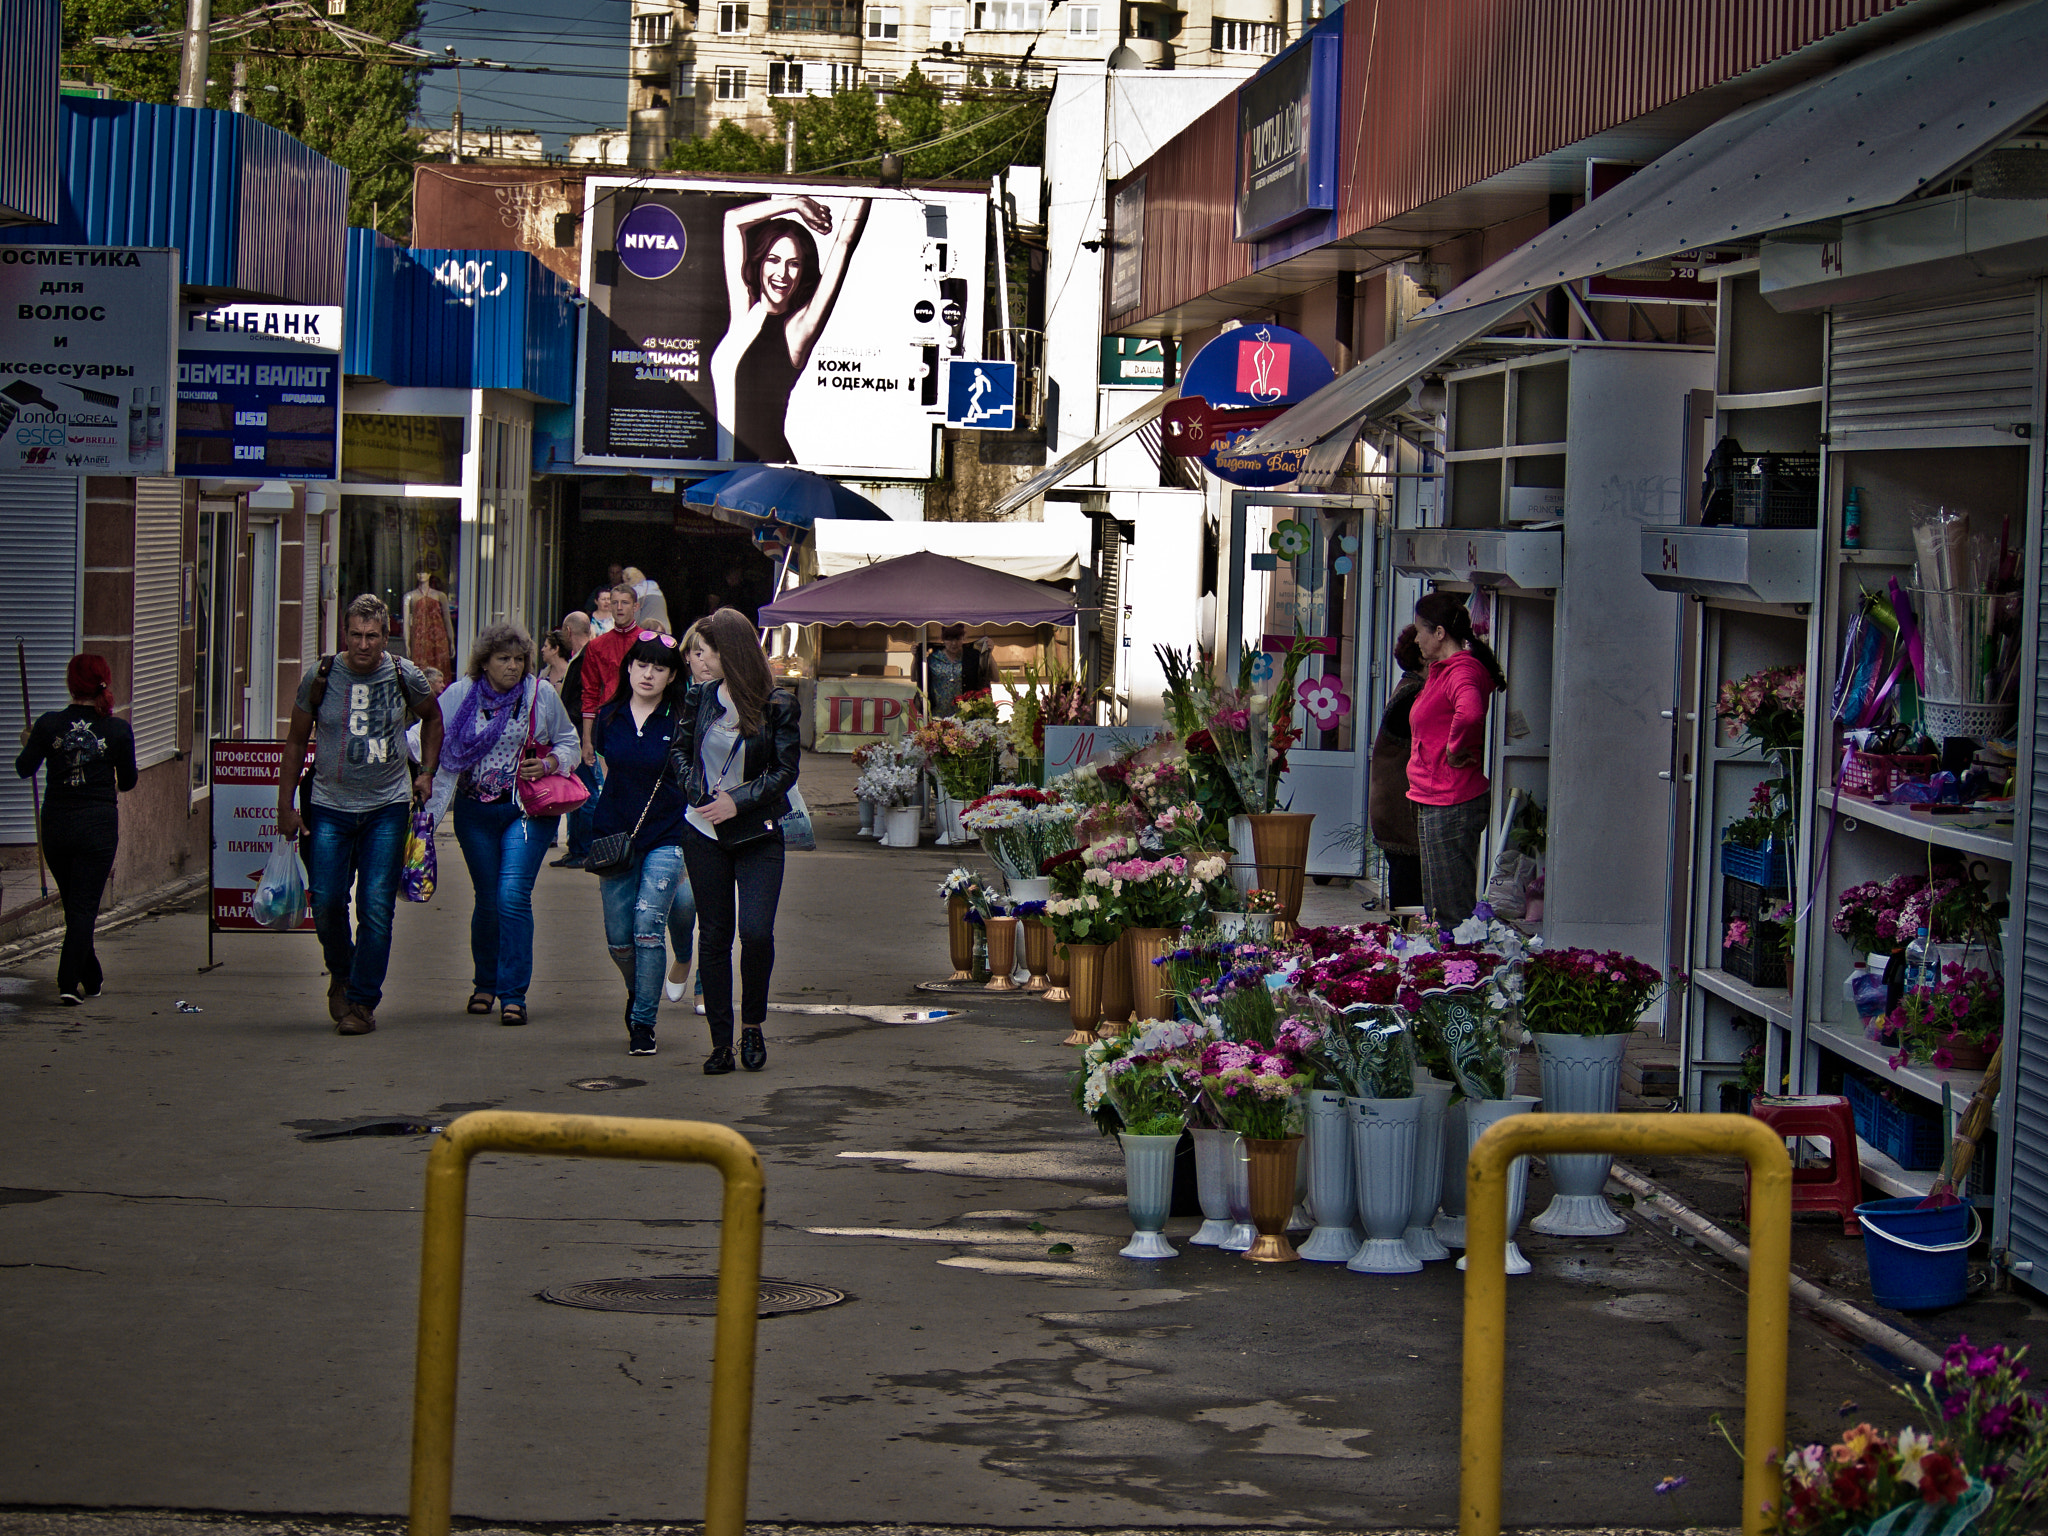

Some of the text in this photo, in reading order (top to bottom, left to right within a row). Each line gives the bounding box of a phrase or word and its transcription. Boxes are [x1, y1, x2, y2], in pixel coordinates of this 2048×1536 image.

[625, 233, 680, 250] NIVEA
[0, 250, 141, 267] ОСМЕТИКА
[1678, 267, 1695, 279] 20
[40, 281, 84, 295] для
[188, 310, 320, 335] ГЕНБАНК
[53, 335, 68, 348] и
[301, 336, 321, 344] 1993
[643, 337, 656, 348] 48
[611, 350, 700, 367] НЕВИДИМОЙ
[0, 362, 134, 380] ксессуары
[818, 360, 861, 373] КОЖИ
[177, 363, 331, 387] ОБМЕН ВАЛЮТ
[635, 366, 699, 383] ЗАЩИТЫ
[818, 376, 898, 392] И ОДЕЖДЫ
[177, 391, 218, 400] ПОКУПКА
[281, 393, 326, 403] ПРОДАЖА
[16, 411, 66, 424] Londa
[235, 411, 268, 426] USD
[16, 424, 66, 446] estel
[234, 446, 265, 460] EUR
[1267, 453, 1300, 473] Вас!
[215, 766, 271, 777] КОСМЕТИКА
